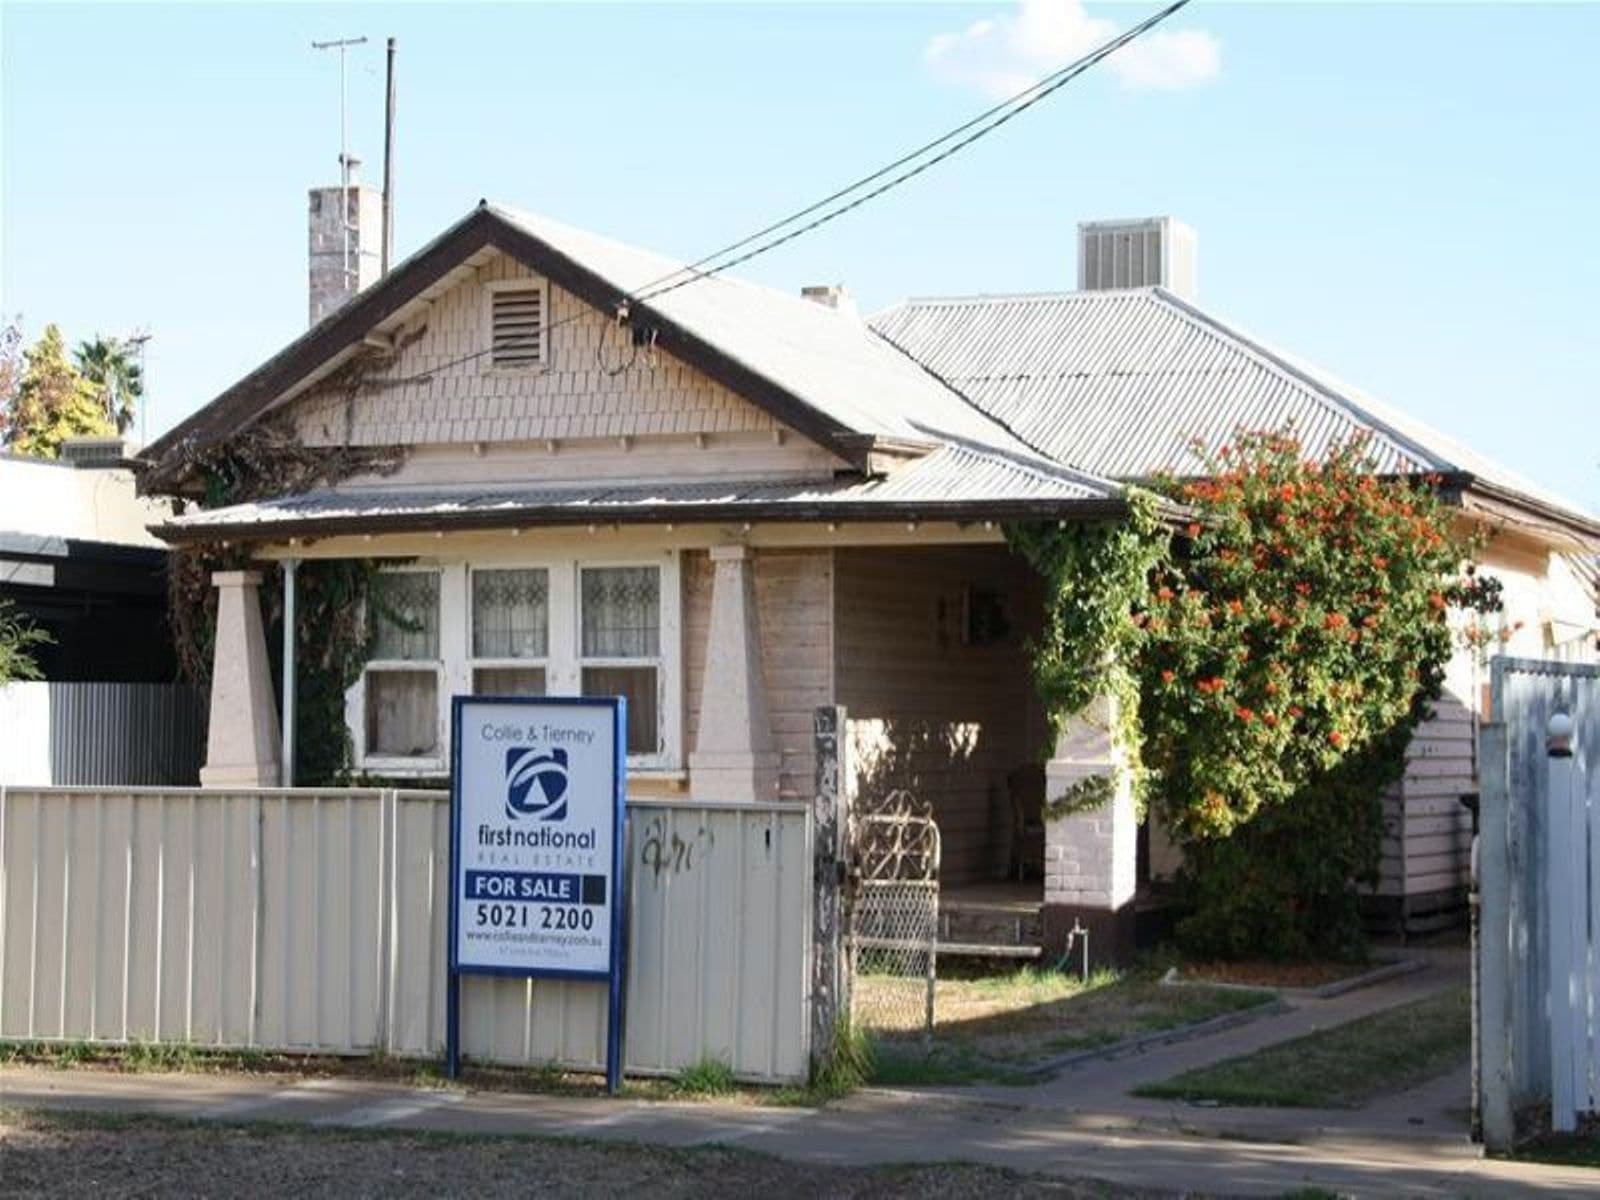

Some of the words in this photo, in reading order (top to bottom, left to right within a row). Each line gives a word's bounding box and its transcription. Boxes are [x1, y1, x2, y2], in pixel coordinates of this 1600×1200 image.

[481, 723, 523, 742] Collie
[526, 725, 538, 742] &
[543, 724, 595, 744] Tierney
[478, 853, 519, 865] REAL
[534, 854, 595, 868] ESTATE
[475, 876, 516, 897] FOR
[521, 878, 571, 898] SALE
[476, 904, 527, 928] 5021
[541, 907, 594, 931] 2200
